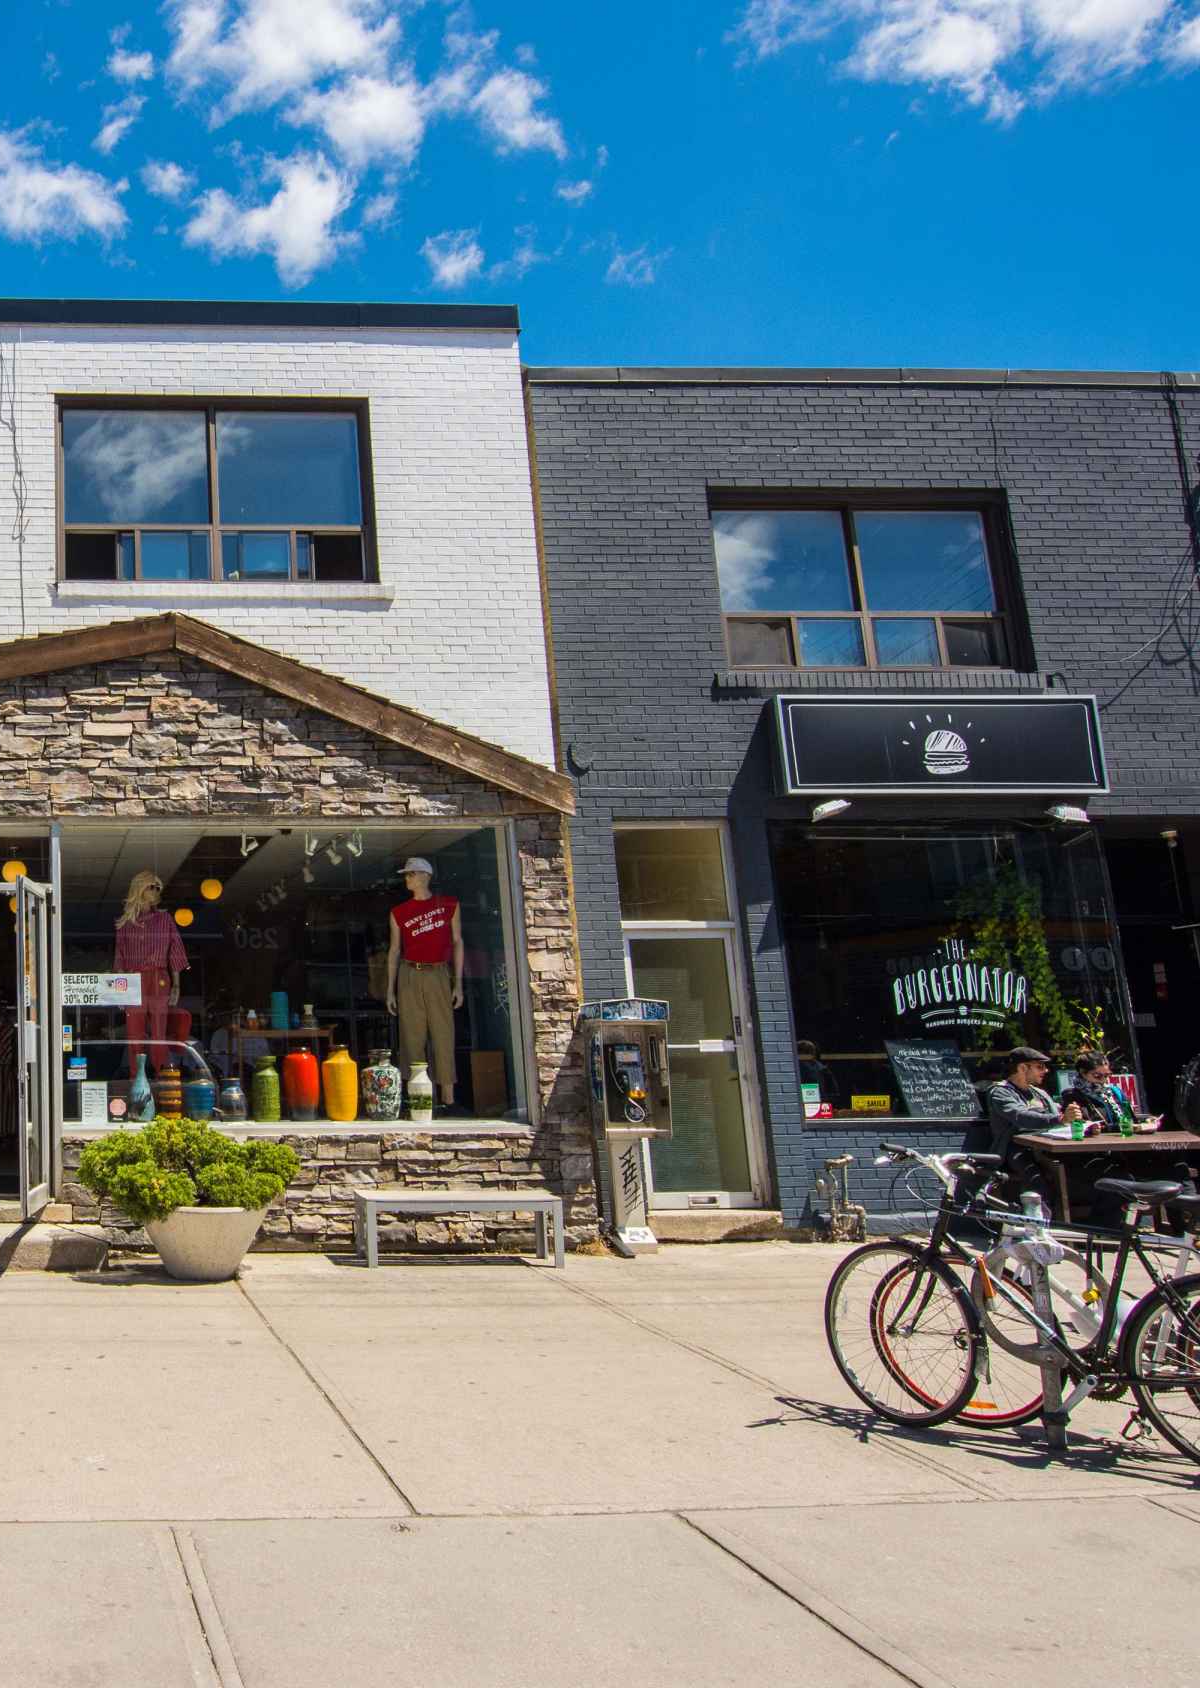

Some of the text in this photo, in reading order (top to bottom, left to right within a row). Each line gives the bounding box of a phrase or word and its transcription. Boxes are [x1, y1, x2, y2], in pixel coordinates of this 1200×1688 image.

[945, 938, 968, 961] THE
[63, 975, 99, 985] SELECTED
[893, 963, 1028, 1016] BURGERNATOR
[63, 994, 99, 1004] 30% OFF
